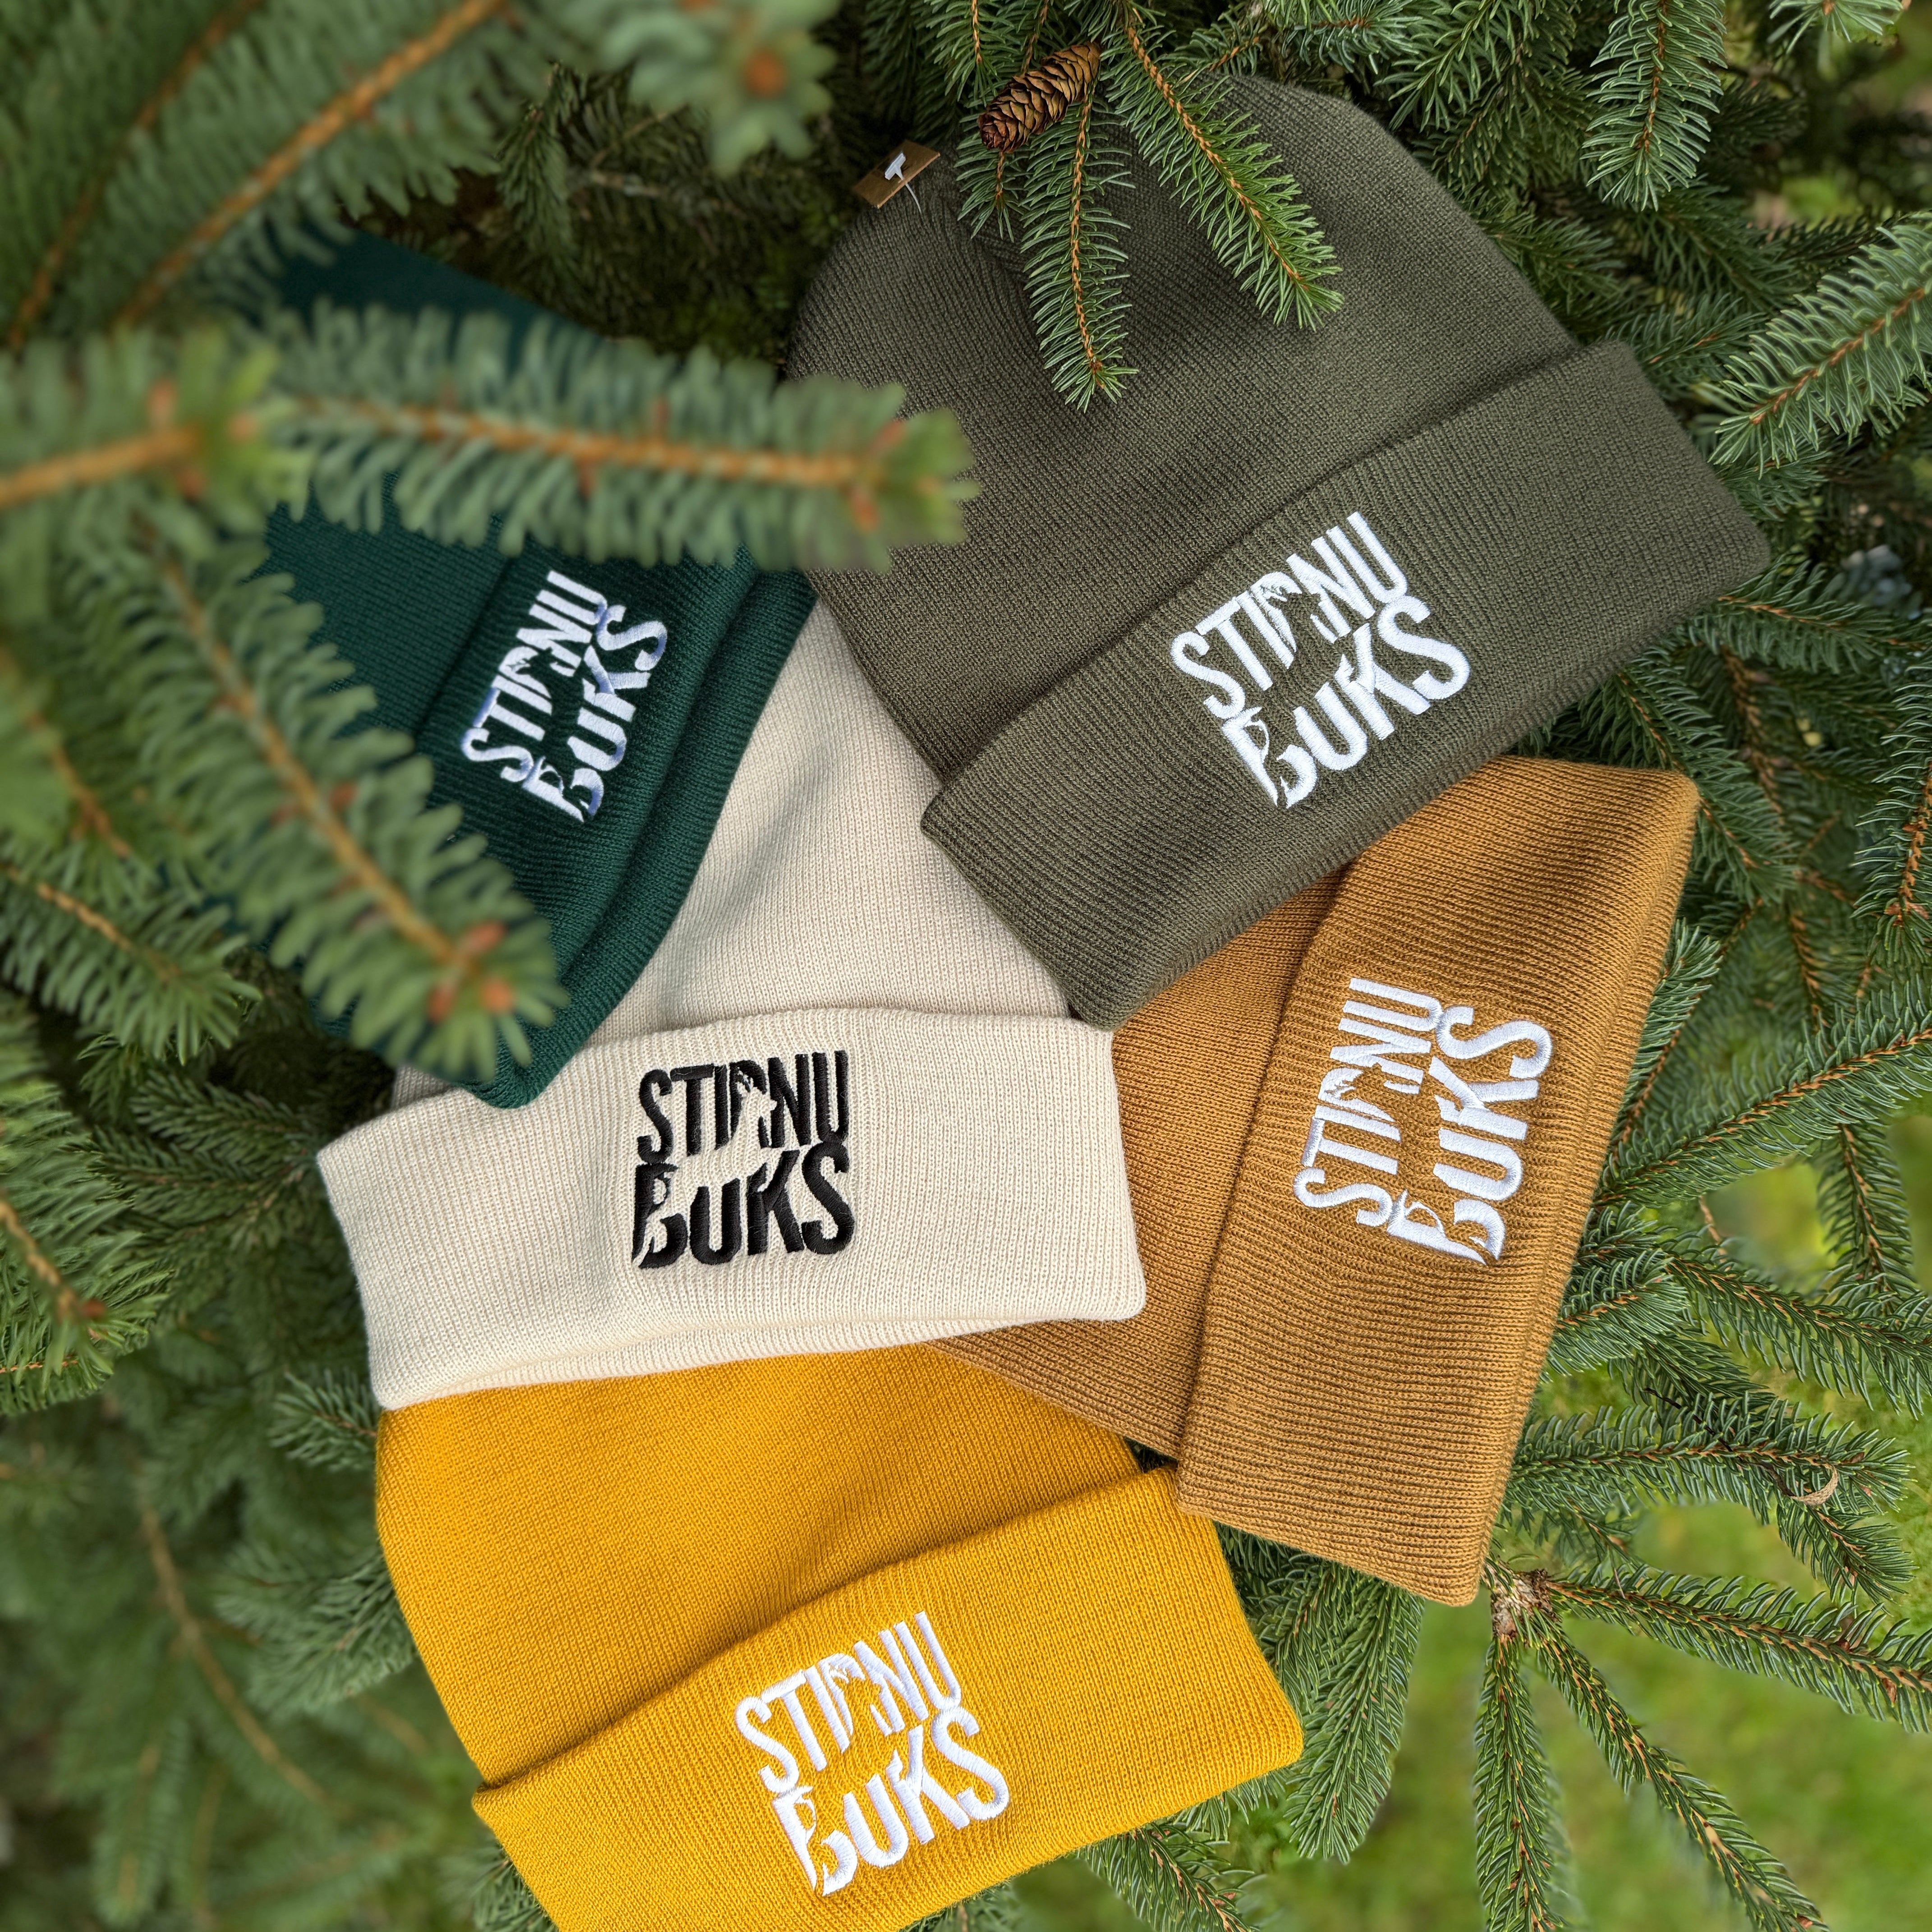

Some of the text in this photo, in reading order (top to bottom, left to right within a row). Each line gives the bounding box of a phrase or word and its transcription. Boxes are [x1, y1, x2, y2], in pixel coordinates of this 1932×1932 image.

[522, 605, 667, 823] BUKS
[1222, 595, 1470, 808] BUKS
[631, 1142, 855, 1269] BUKS
[1387, 1006, 1552, 1264] BUKS
[772, 1707, 1009, 1896] BUKS
